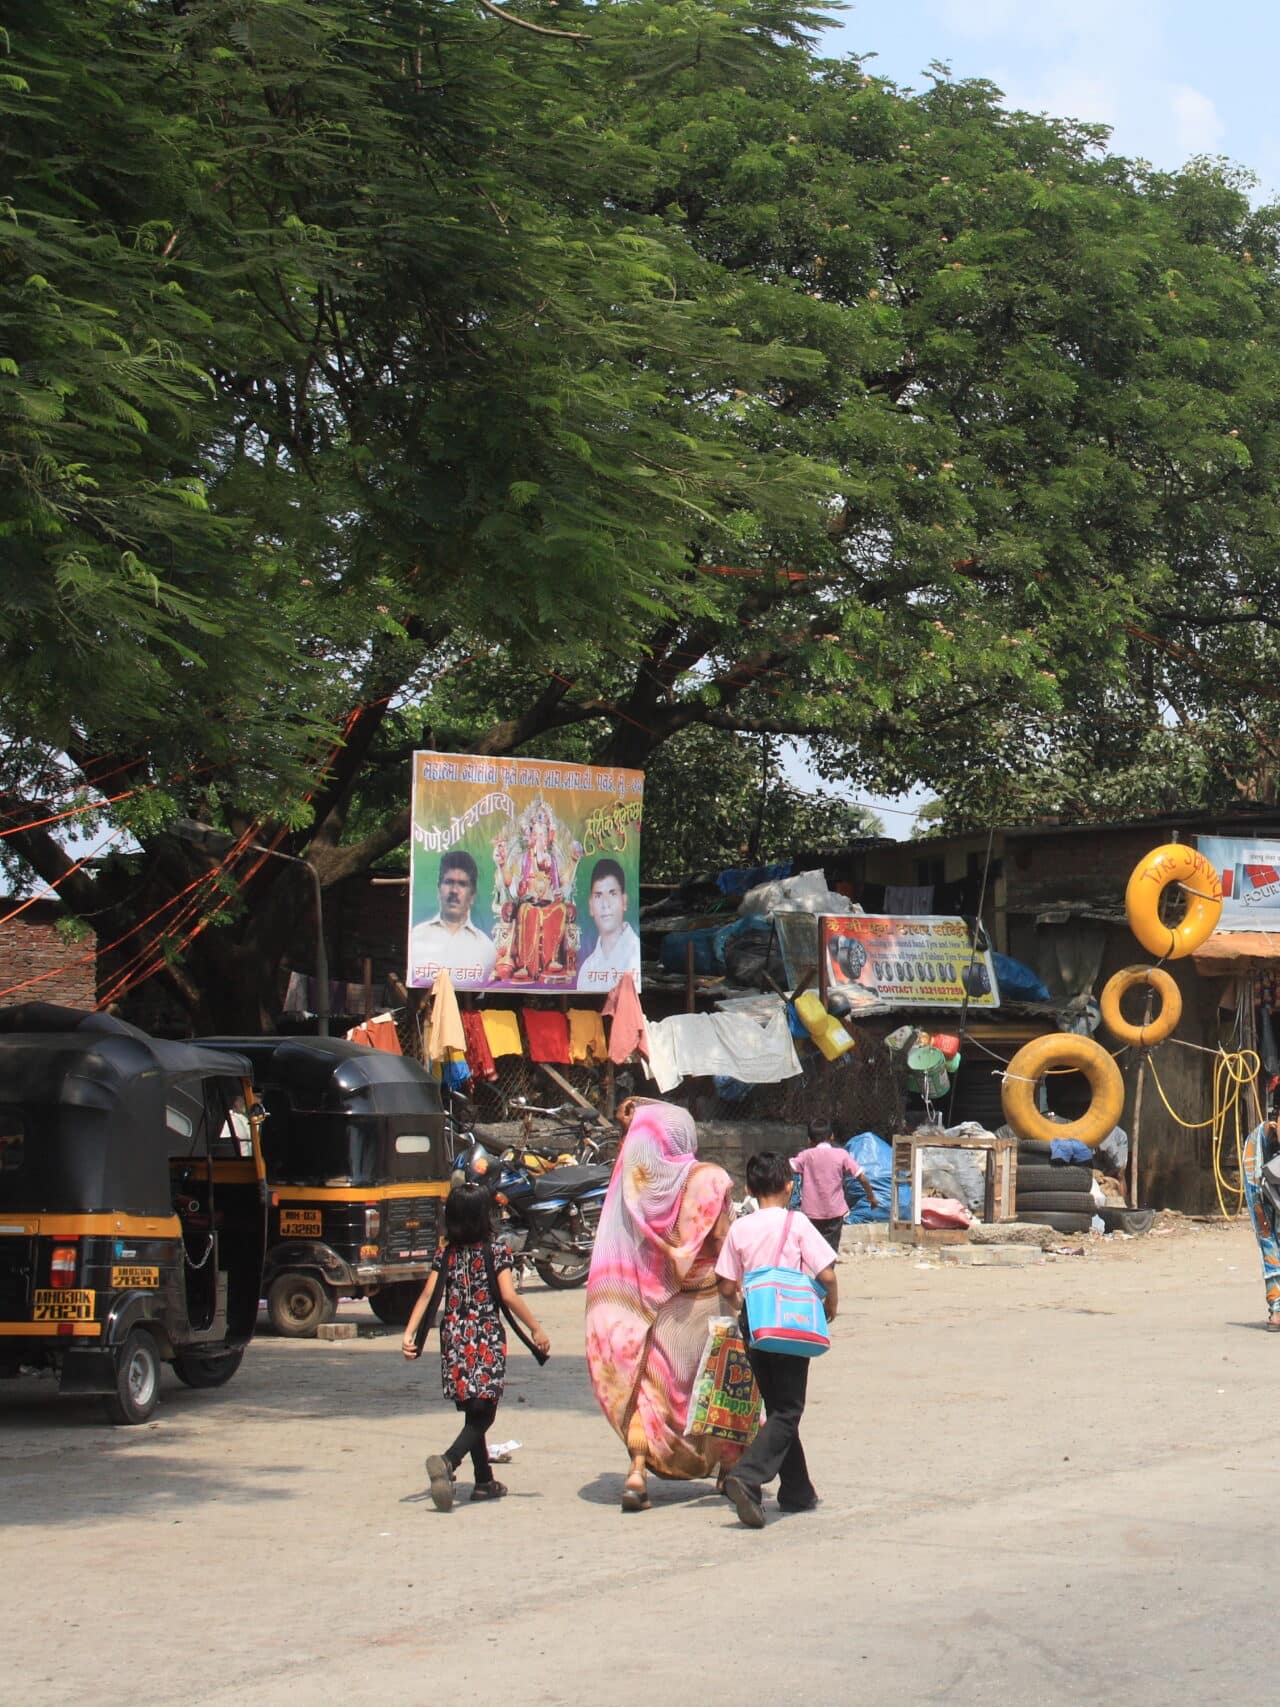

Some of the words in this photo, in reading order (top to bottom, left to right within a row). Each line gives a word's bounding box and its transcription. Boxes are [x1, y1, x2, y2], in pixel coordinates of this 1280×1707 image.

[1140, 853, 1176, 885] TYRE
[1242, 886, 1279, 907] FOUR
[878, 985, 913, 994] CONTACT
[36, 1305, 90, 1319] 7820
[729, 1366, 751, 1384] Be
[713, 1389, 755, 1417] Happy
